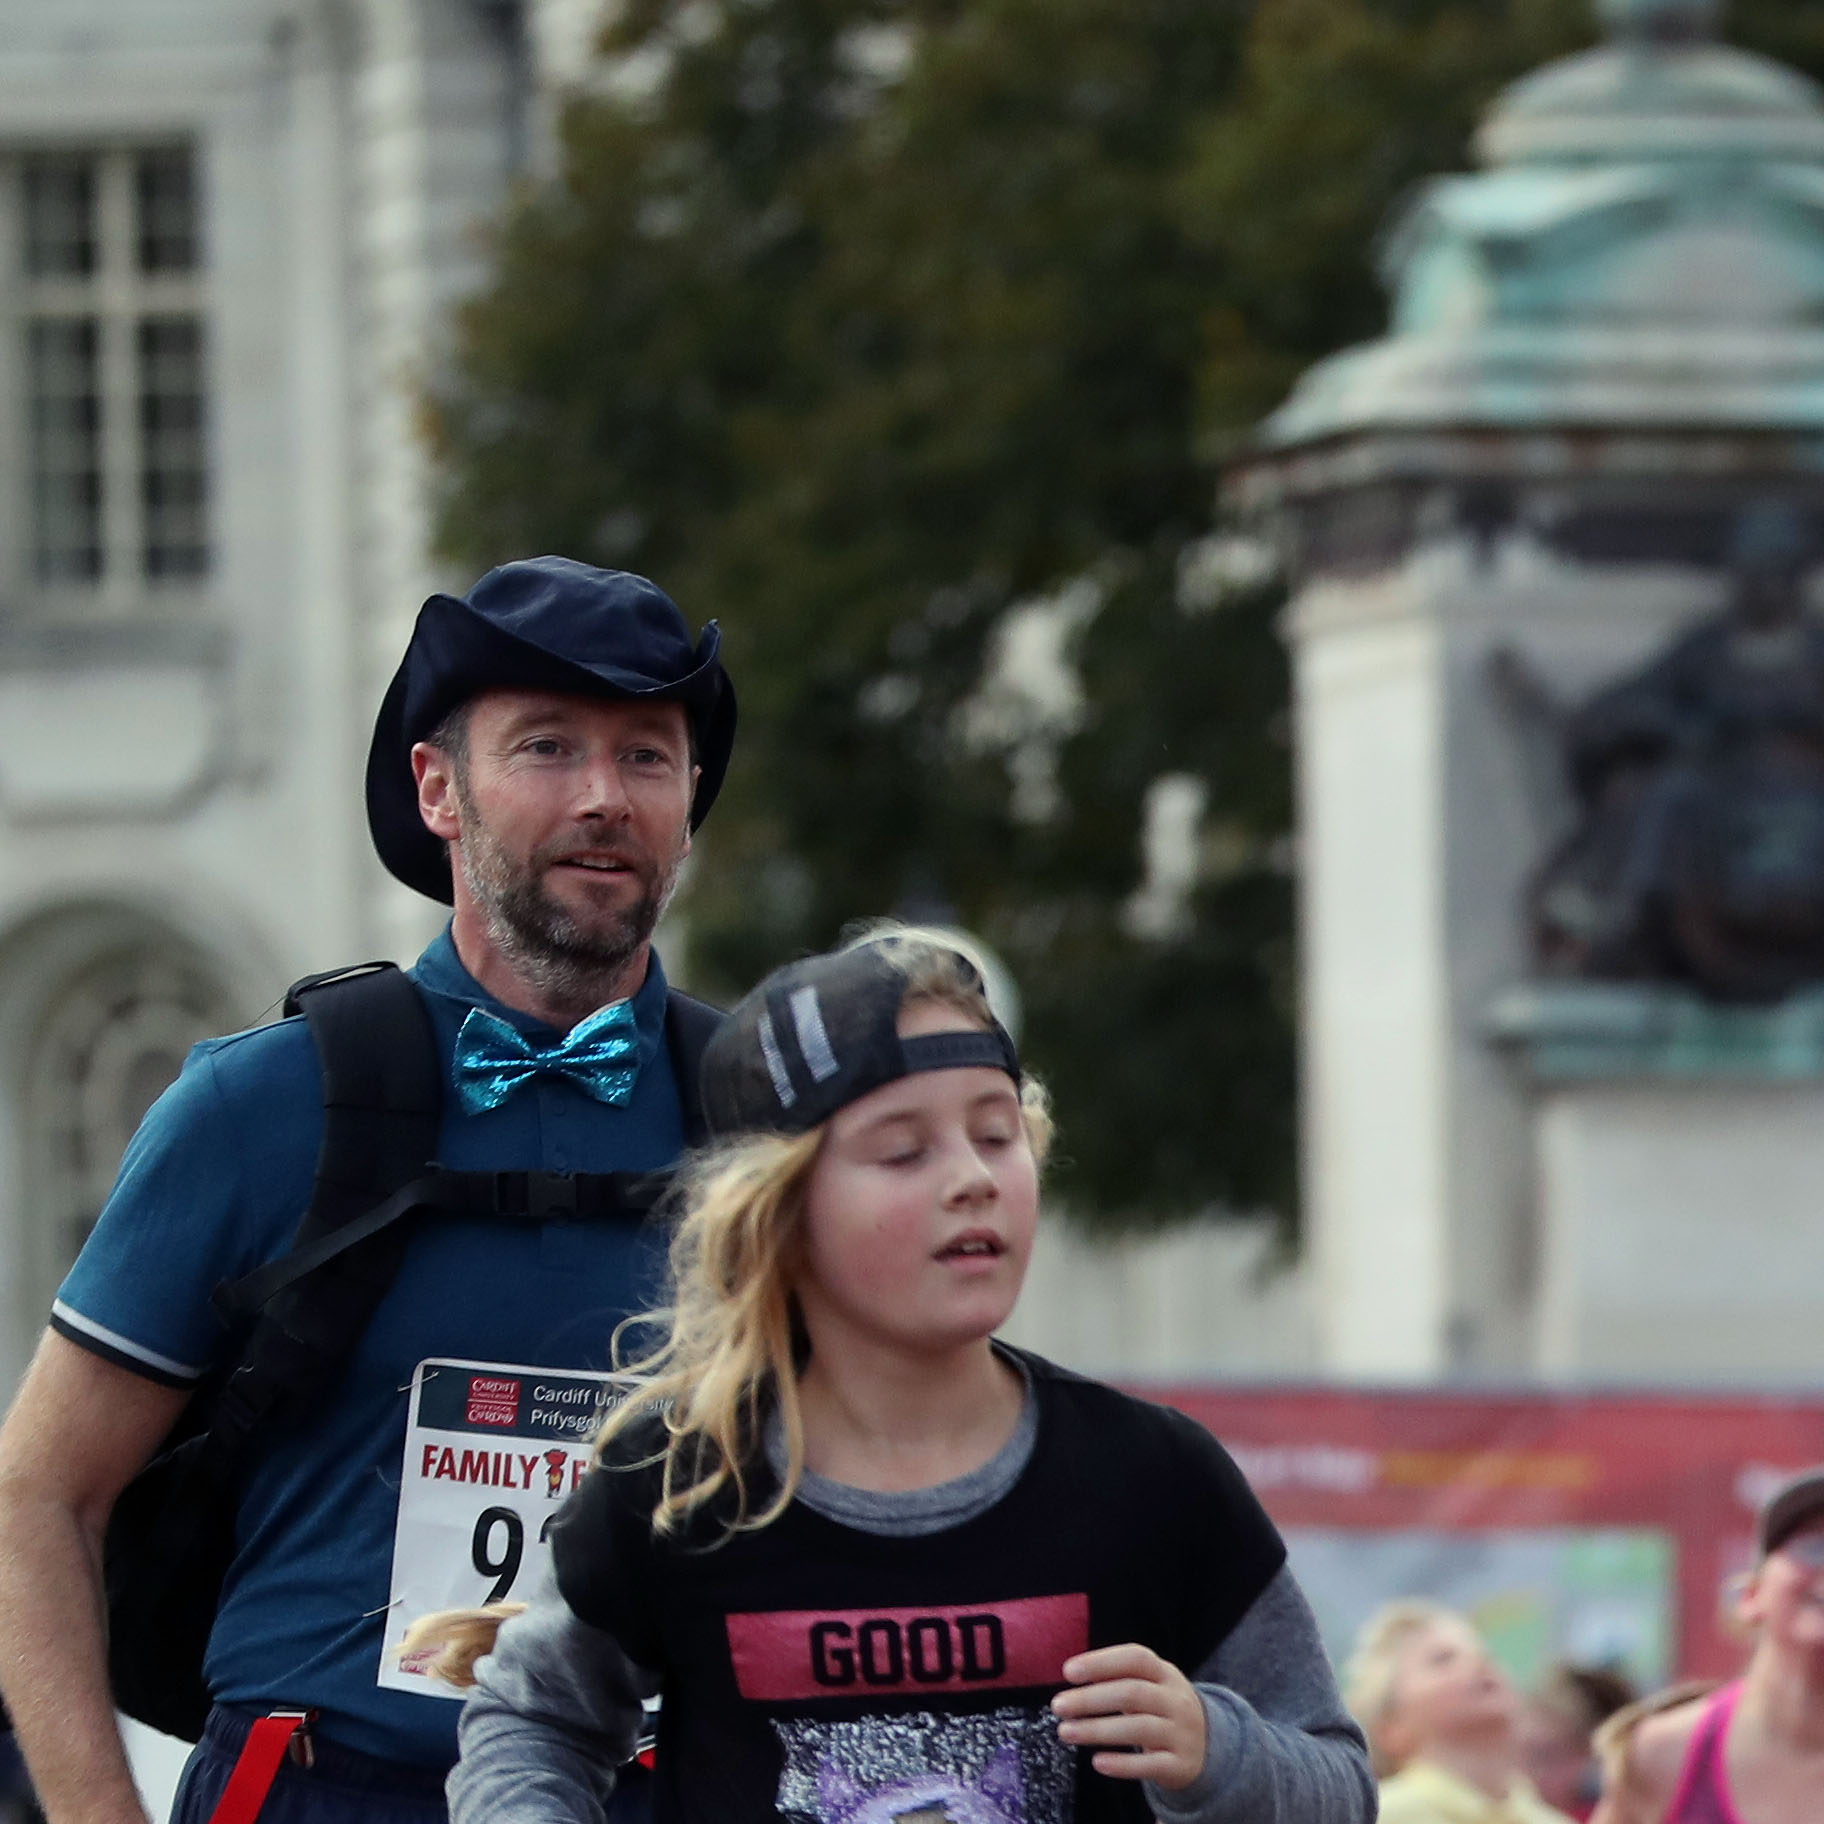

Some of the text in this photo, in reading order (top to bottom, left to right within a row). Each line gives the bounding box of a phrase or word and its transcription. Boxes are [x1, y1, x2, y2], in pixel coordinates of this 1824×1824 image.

[533, 1385, 592, 1405] Cardiff
[530, 1409, 600, 1431] Prifysgol
[421, 1444, 540, 1490] FAMILY
[810, 1613, 1006, 1687] GOOD
